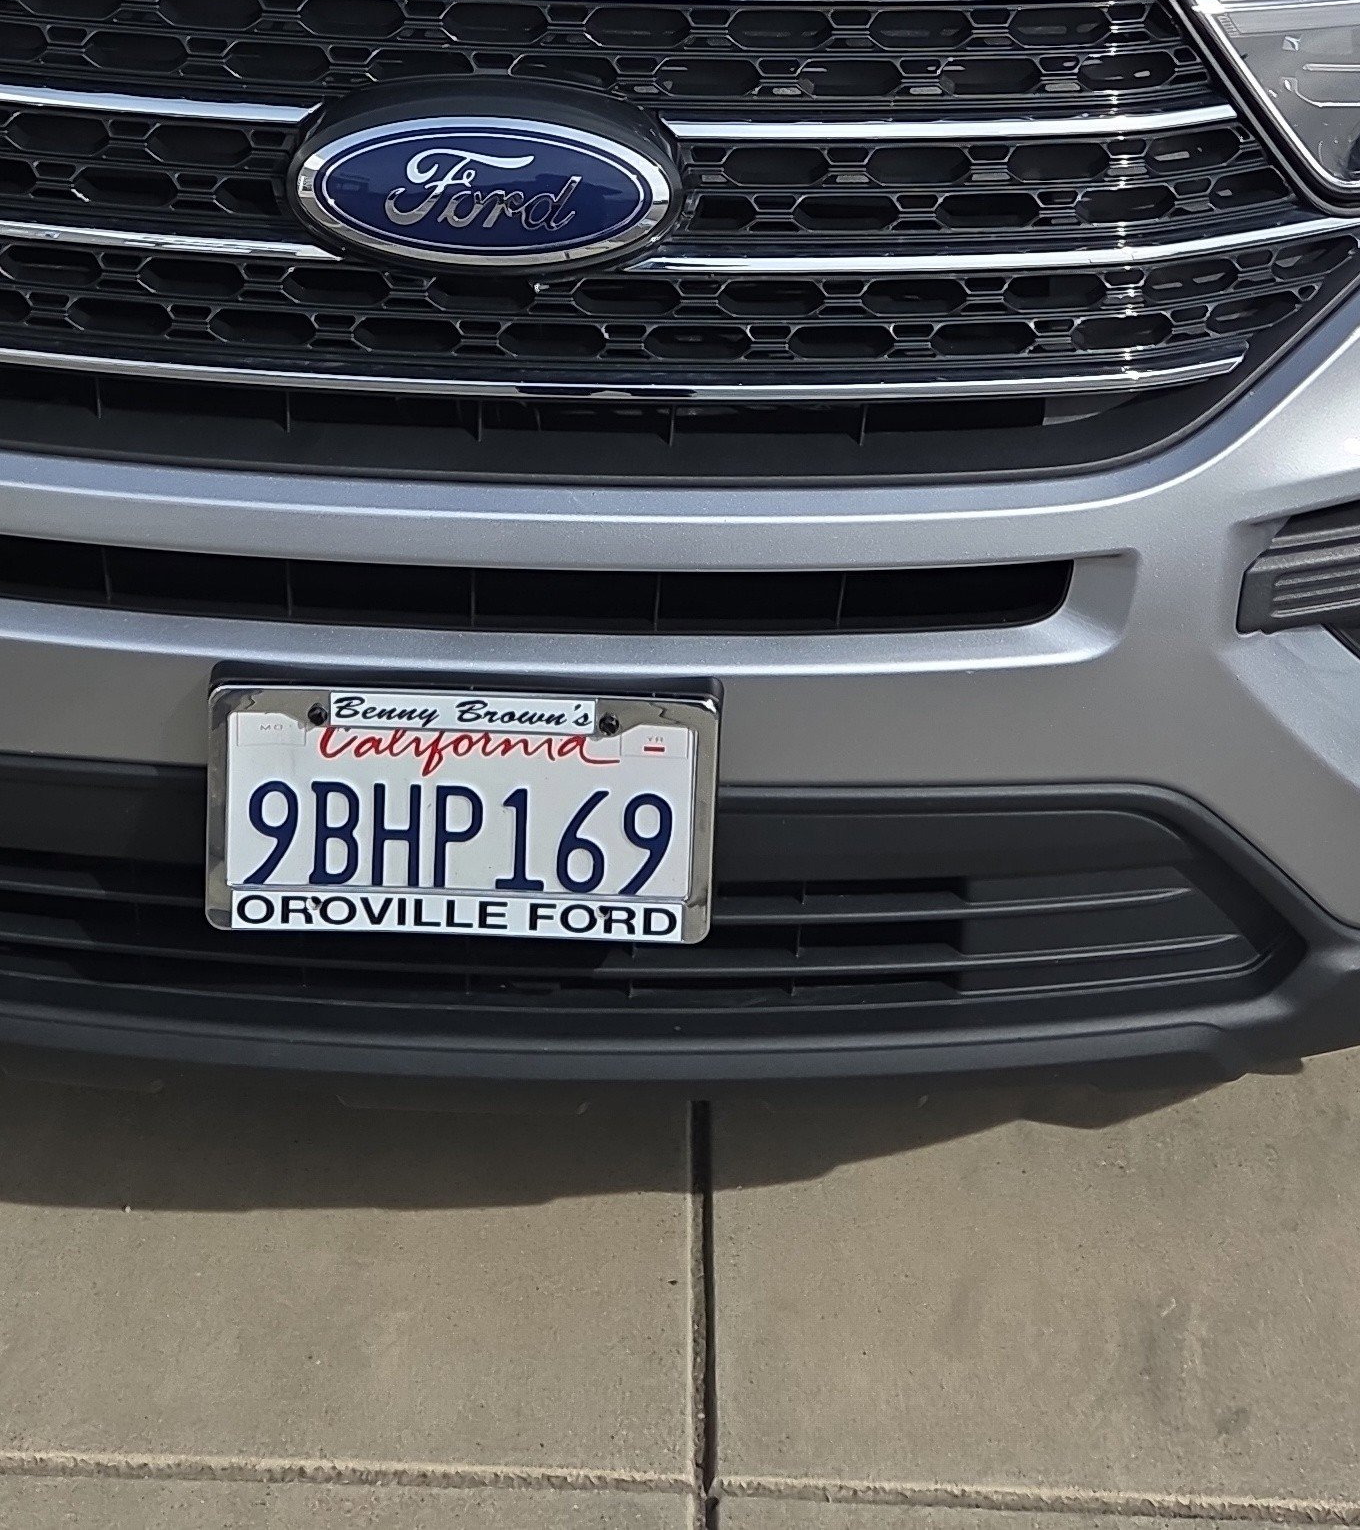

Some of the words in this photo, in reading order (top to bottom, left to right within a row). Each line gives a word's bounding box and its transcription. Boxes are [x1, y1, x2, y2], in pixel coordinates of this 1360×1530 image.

[384, 148, 582, 232] Ford
[332, 696, 440, 728] Benny
[454, 698, 593, 727] Brown's
[319, 726, 621, 777] California
[242, 779, 674, 895] 9BHP169
[237, 894, 509, 930] OROVILLE
[528, 902, 678, 937] FORD
